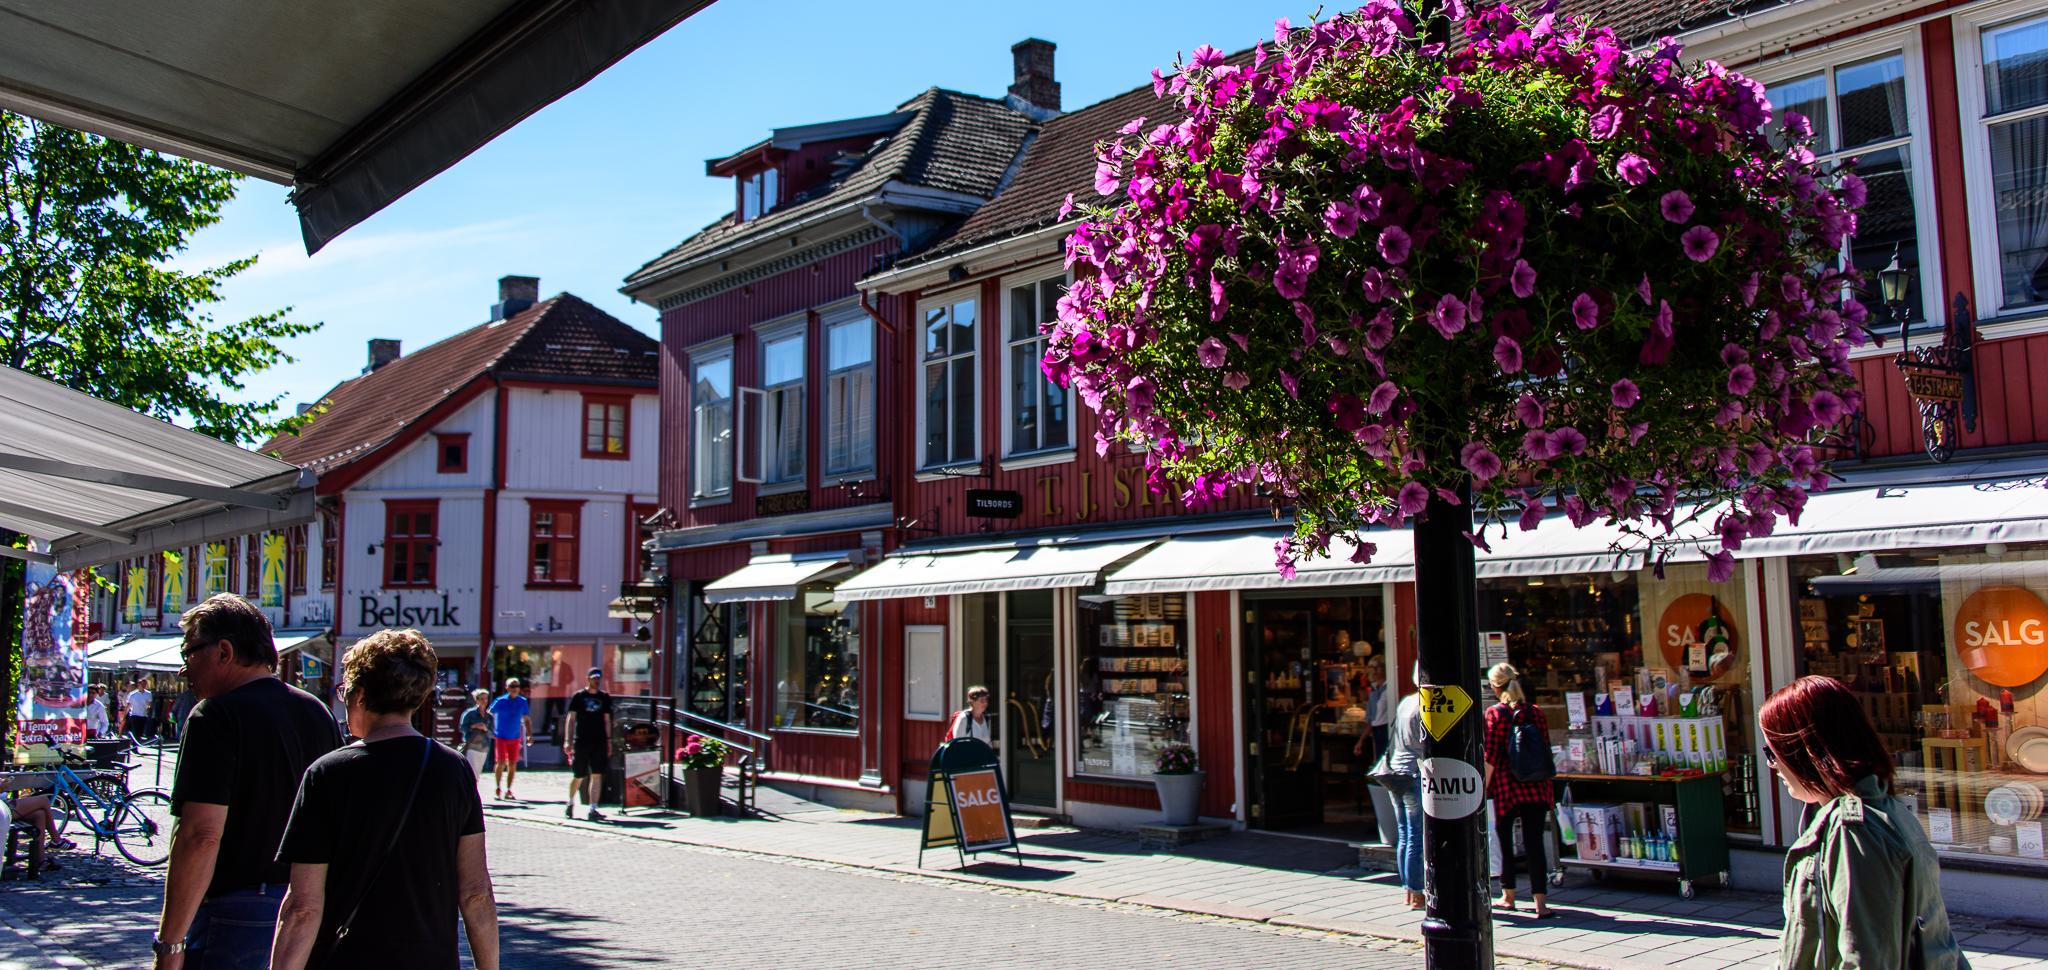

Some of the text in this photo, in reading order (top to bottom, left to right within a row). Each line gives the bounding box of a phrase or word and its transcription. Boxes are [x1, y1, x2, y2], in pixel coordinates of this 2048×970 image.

[1076, 472, 1097, 520] J.
[358, 594, 461, 627] Belsvik
[1667, 624, 1697, 647] SA
[1965, 618, 2045, 647] SALG
[20, 733, 43, 742] Extra
[29, 722, 58, 733] Tempo
[1422, 777, 1476, 795] FAMU
[957, 788, 999, 808] SALG
